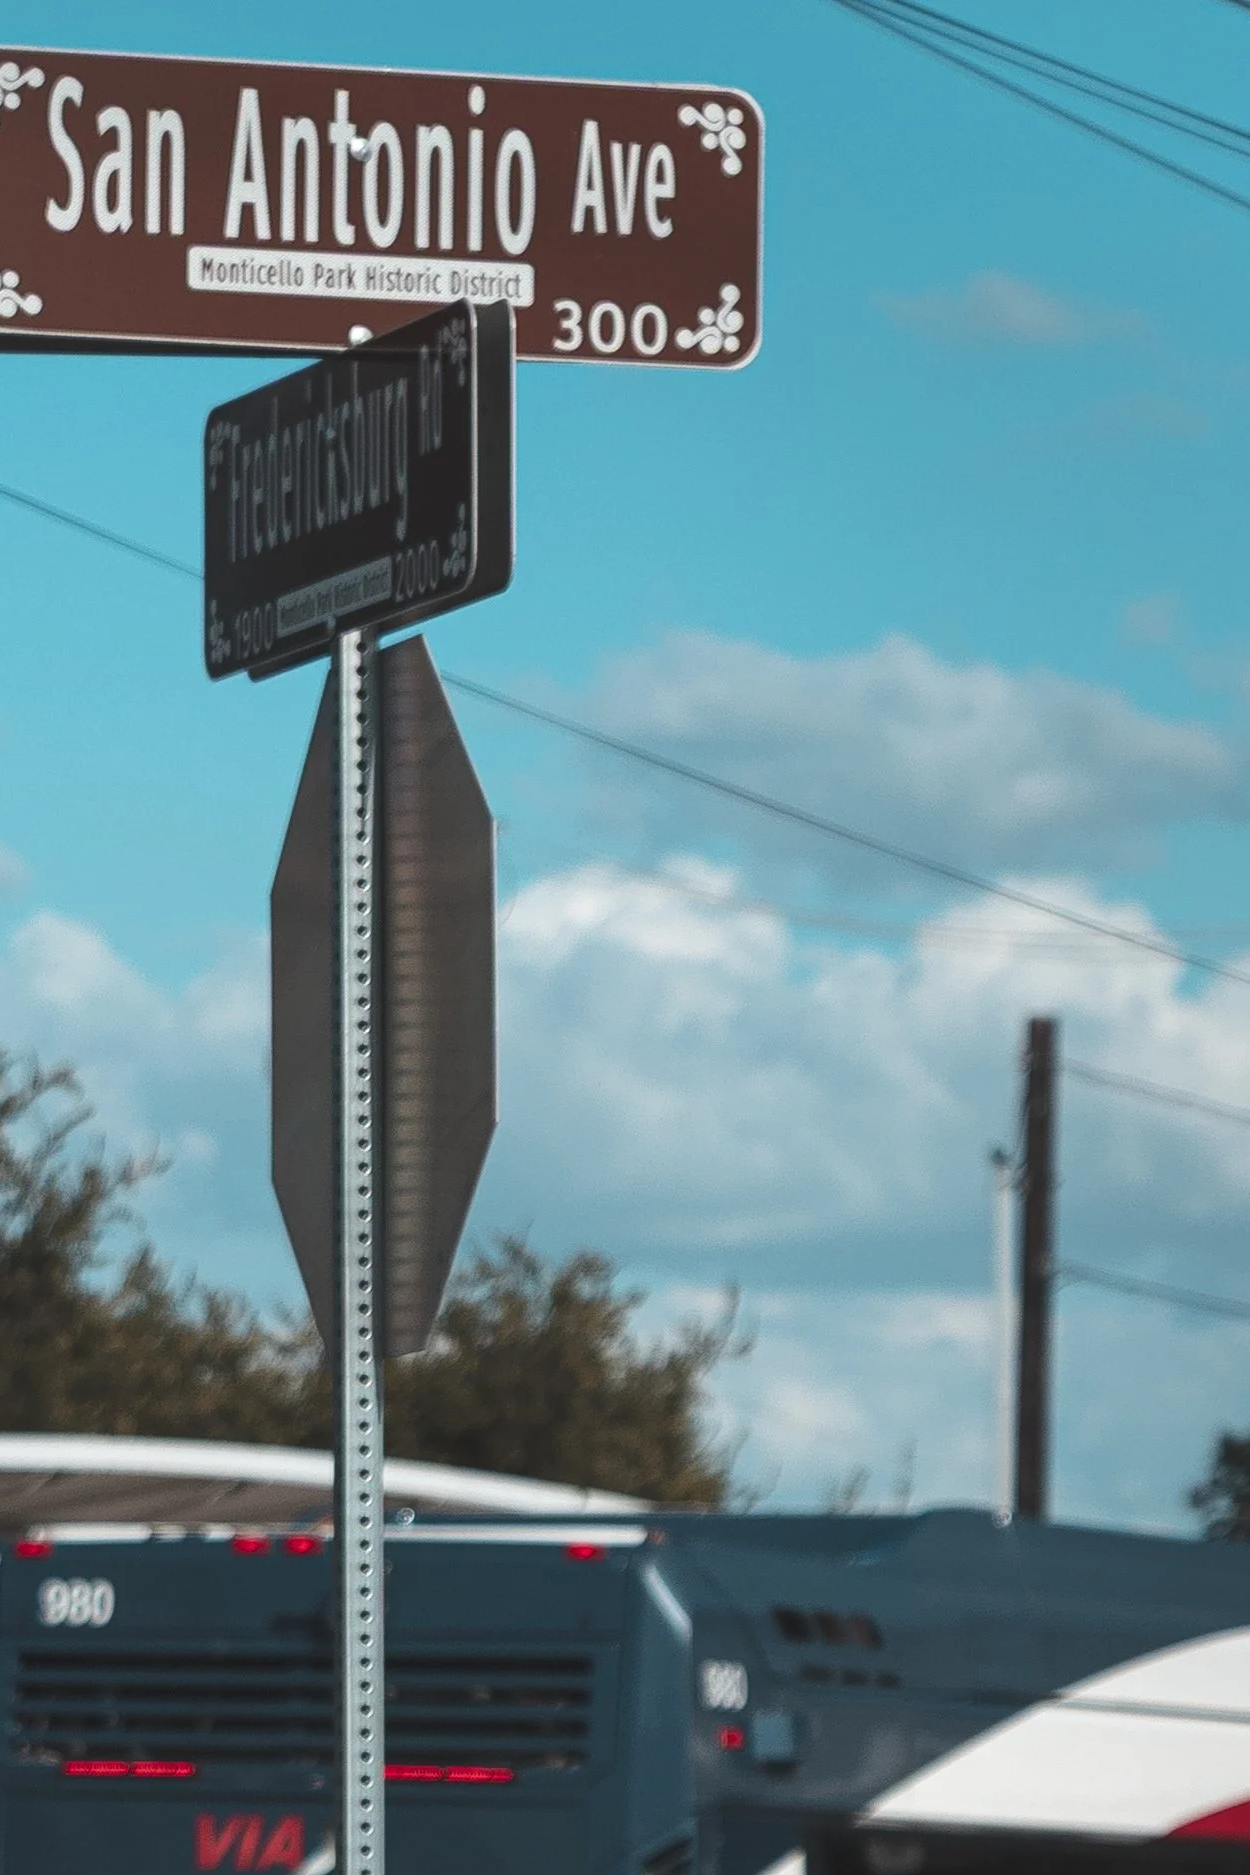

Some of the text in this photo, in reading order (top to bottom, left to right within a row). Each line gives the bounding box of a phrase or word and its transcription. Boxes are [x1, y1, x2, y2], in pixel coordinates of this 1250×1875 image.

[45, 76, 676, 255] San Antonio Ave
[200, 256, 523, 300] Monticello Park Historic District
[552, 299, 668, 355] 300
[229, 360, 409, 563] Fredericksburg
[395, 540, 440, 603] 2000
[235, 601, 275, 660] 1900
[38, 1577, 115, 1627] 980
[196, 1813, 305, 1872] VIA
